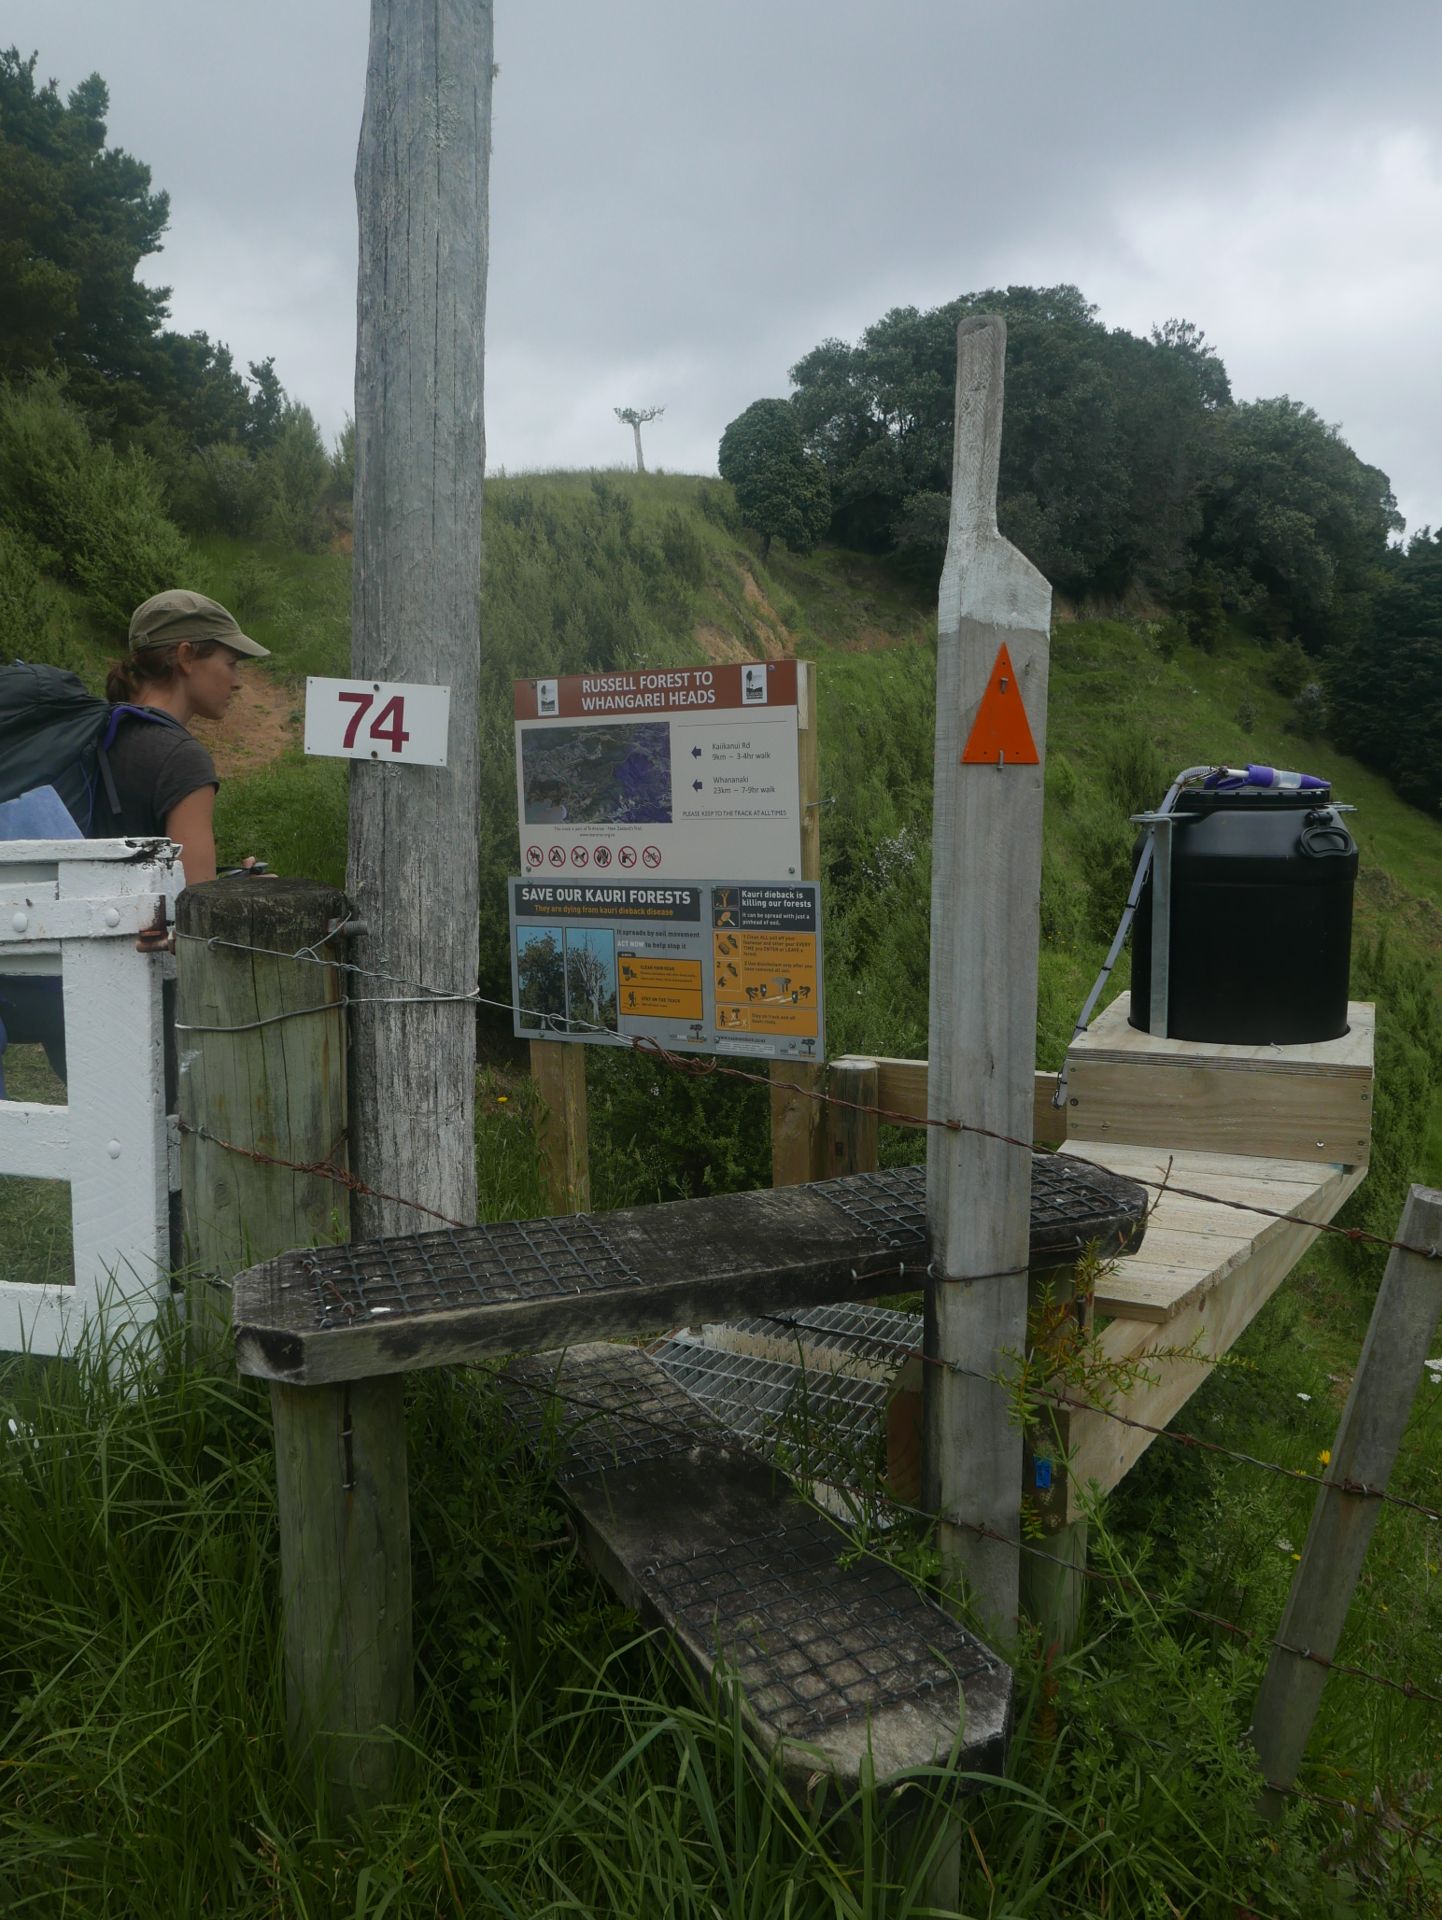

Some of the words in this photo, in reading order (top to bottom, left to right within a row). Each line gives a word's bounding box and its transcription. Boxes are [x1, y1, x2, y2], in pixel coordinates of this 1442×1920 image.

[582, 675, 636, 693] RUSSELL
[640, 672, 690, 689] FOREST
[693, 671, 713, 685] TO
[581, 693, 665, 711] WHANGAREI
[669, 689, 716, 705] HEADS
[338, 691, 410, 753] 74
[713, 776, 749, 784] Whananaki
[522, 888, 553, 901] SAVE
[556, 889, 582, 902] OUR
[586, 889, 626, 903] KAURI
[630, 891, 691, 905] FORESTS
[742, 890, 763, 898] Kauri
[765, 890, 794, 899] dieback
[796, 891, 803, 899] is
[563, 905, 581, 915] dying
[582, 906, 598, 914] from
[599, 906, 618, 914] kauri
[742, 899, 767, 908] killing
[783, 900, 812, 908] forests
